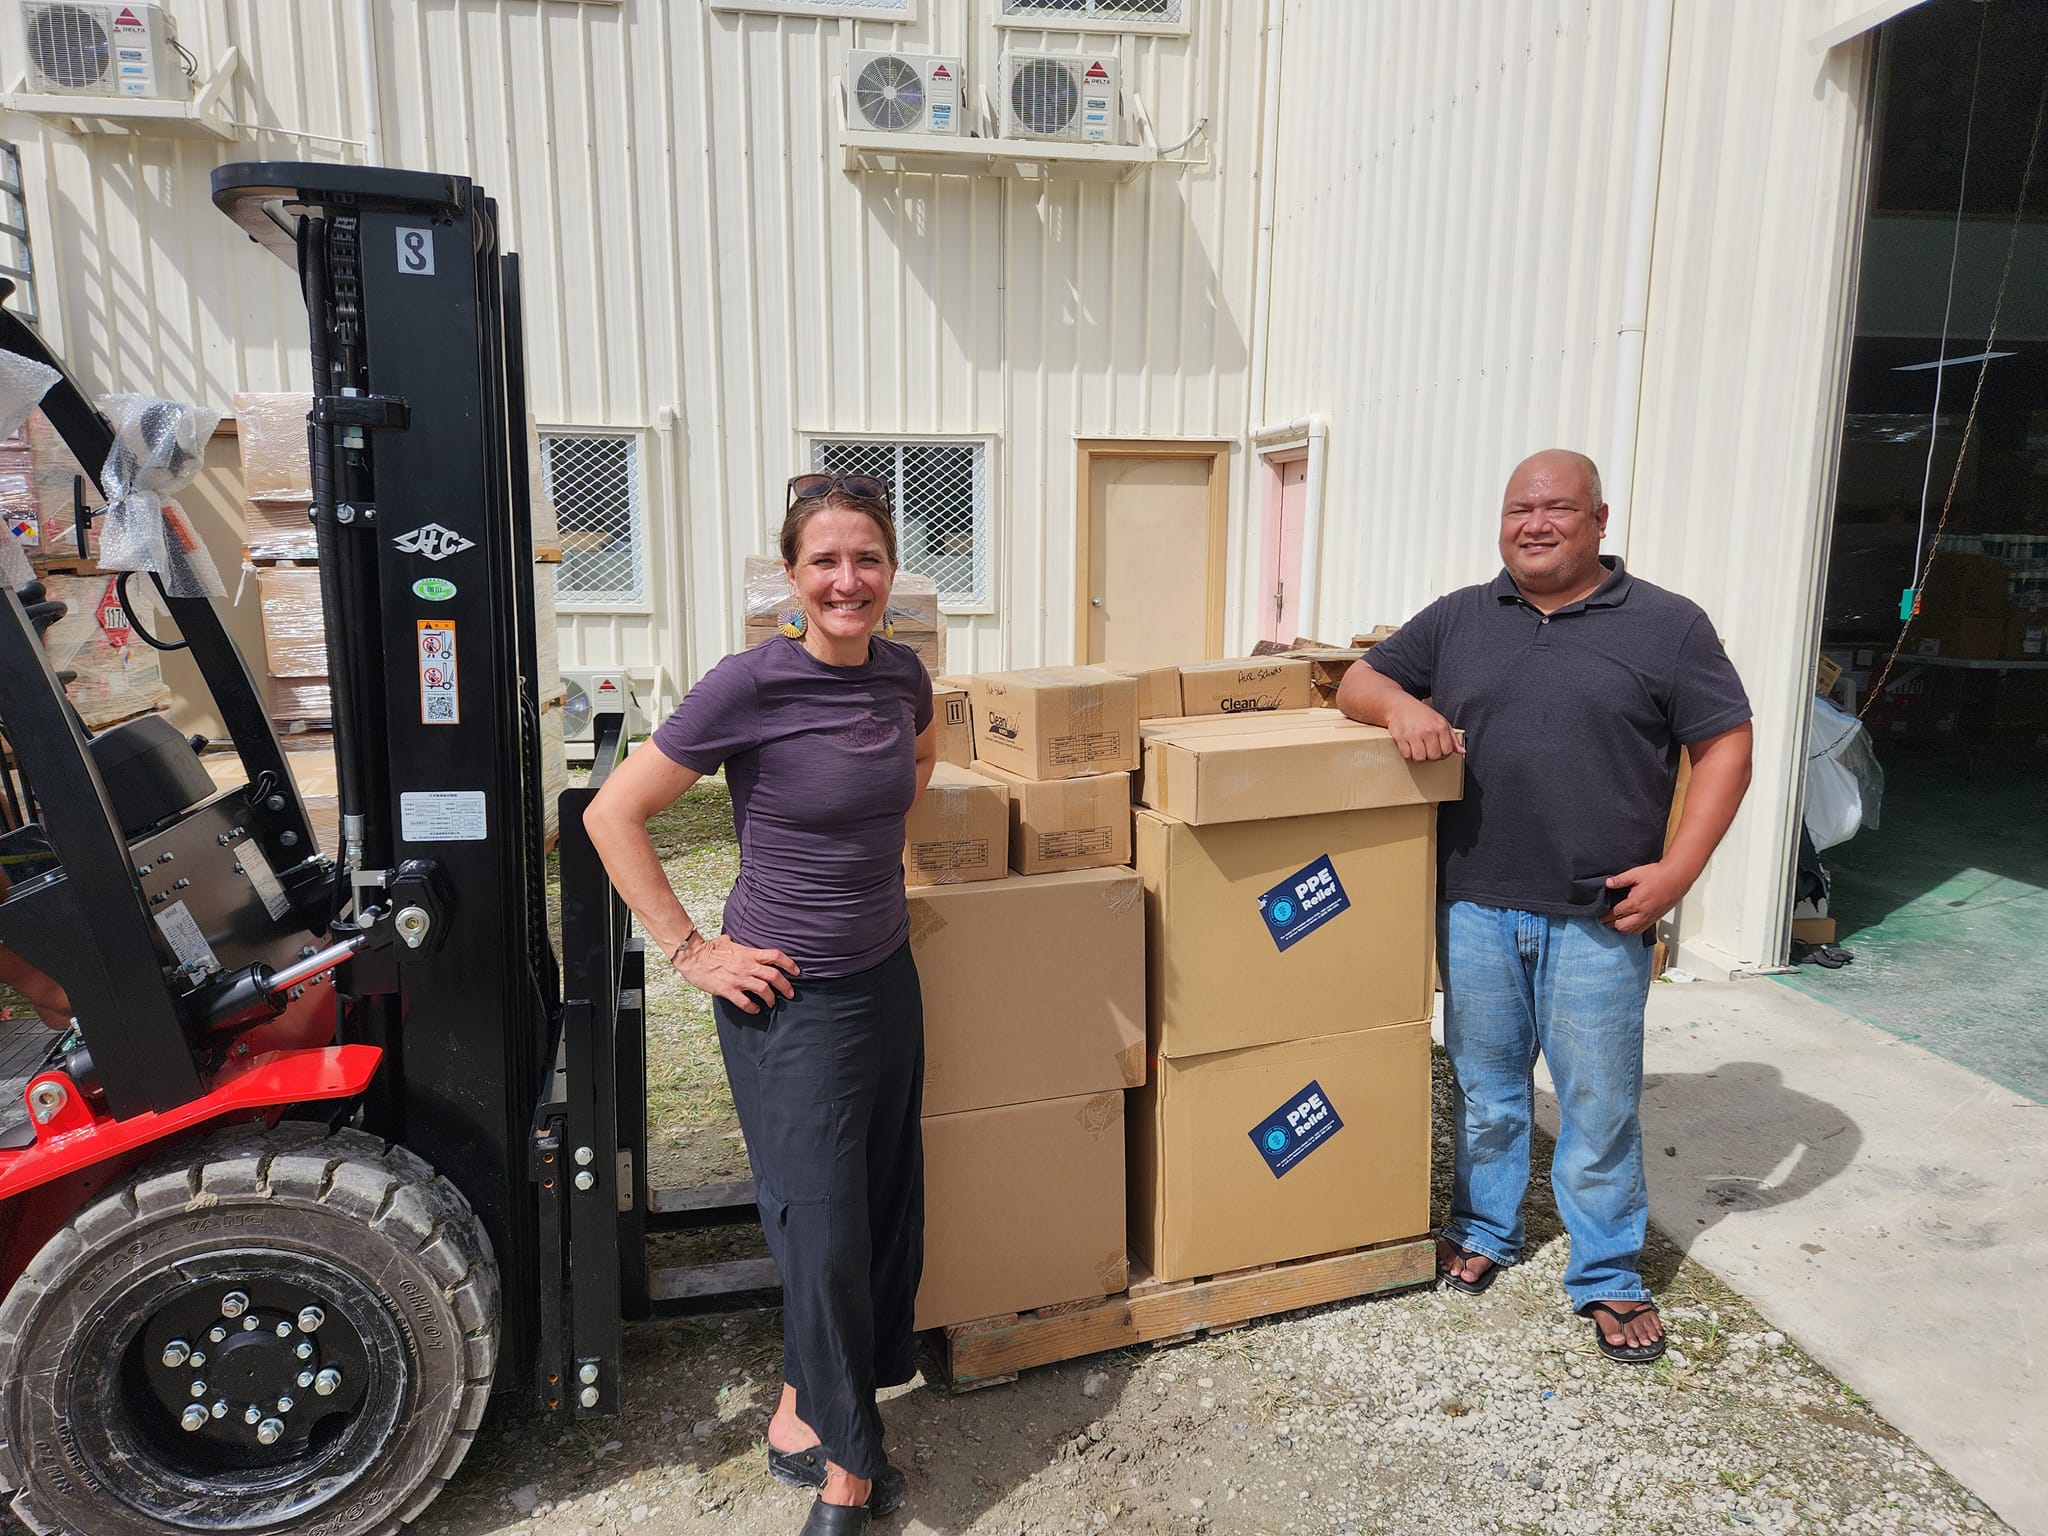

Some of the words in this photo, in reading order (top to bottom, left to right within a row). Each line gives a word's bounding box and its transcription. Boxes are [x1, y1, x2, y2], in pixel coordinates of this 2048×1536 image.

[1295, 867, 1333, 900] PPE
[1301, 881, 1336, 911] Relief
[1286, 1093, 1324, 1127] PPE
[1294, 1105, 1328, 1137] Relief
